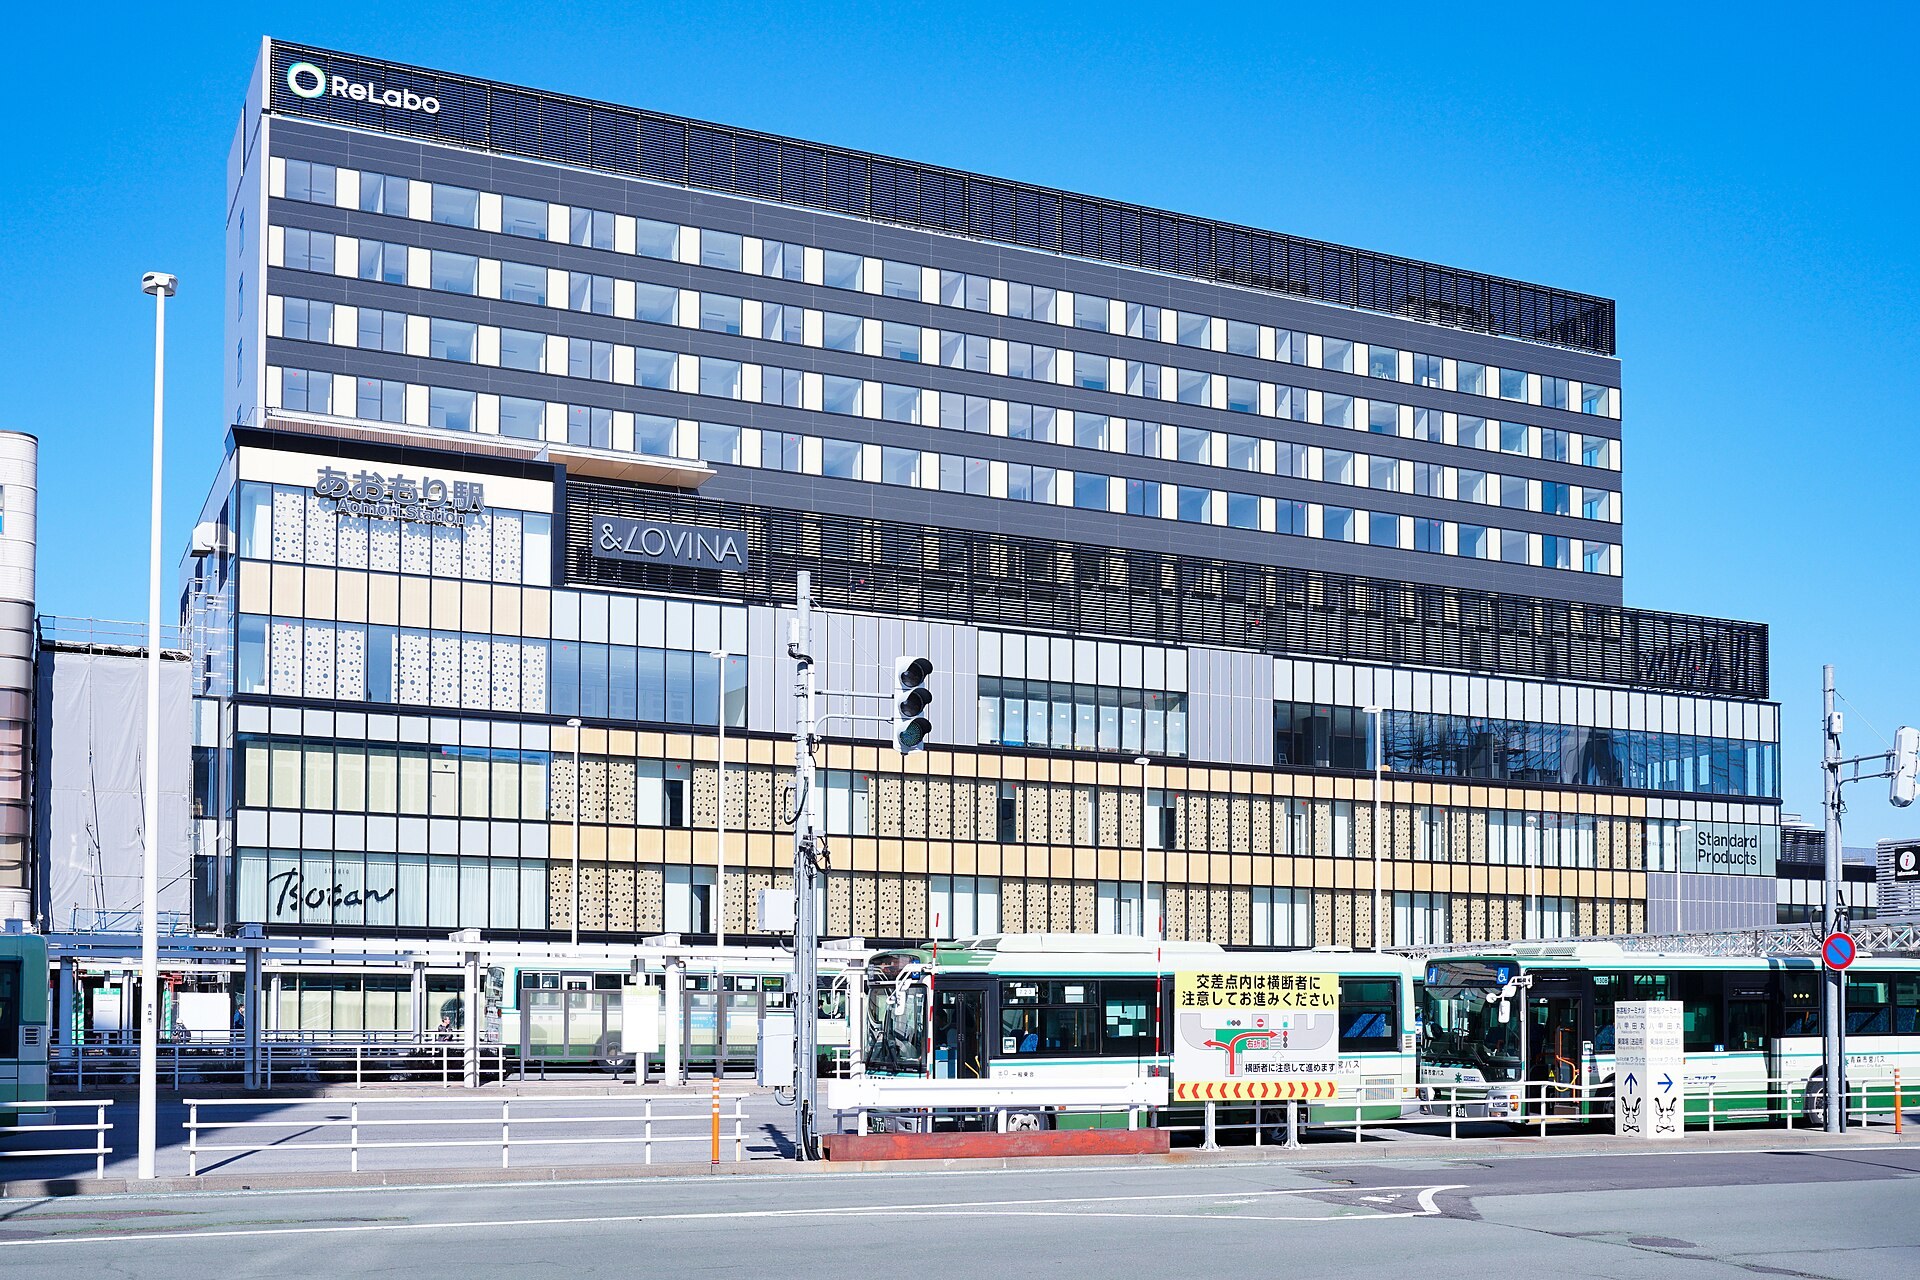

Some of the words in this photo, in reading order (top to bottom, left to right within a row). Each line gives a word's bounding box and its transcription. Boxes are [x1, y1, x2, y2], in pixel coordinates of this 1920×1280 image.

[331, 75, 440, 114] ReLabo
[315, 465, 486, 513] あおもり駅
[336, 498, 400, 516] Aomori
[405, 505, 466, 525] Station
[600, 522, 743, 564] &LOVINA
[1697, 831, 1758, 849] Standard
[1698, 849, 1758, 866] Products
[1196, 974, 1321, 990] 交差点内は横断者に
[1182, 991, 1335, 1007] 注意してお進みください
[1246, 1039, 1268, 1048] 右折車
[1244, 1063, 1336, 1073] 横断者に注意して進めます
